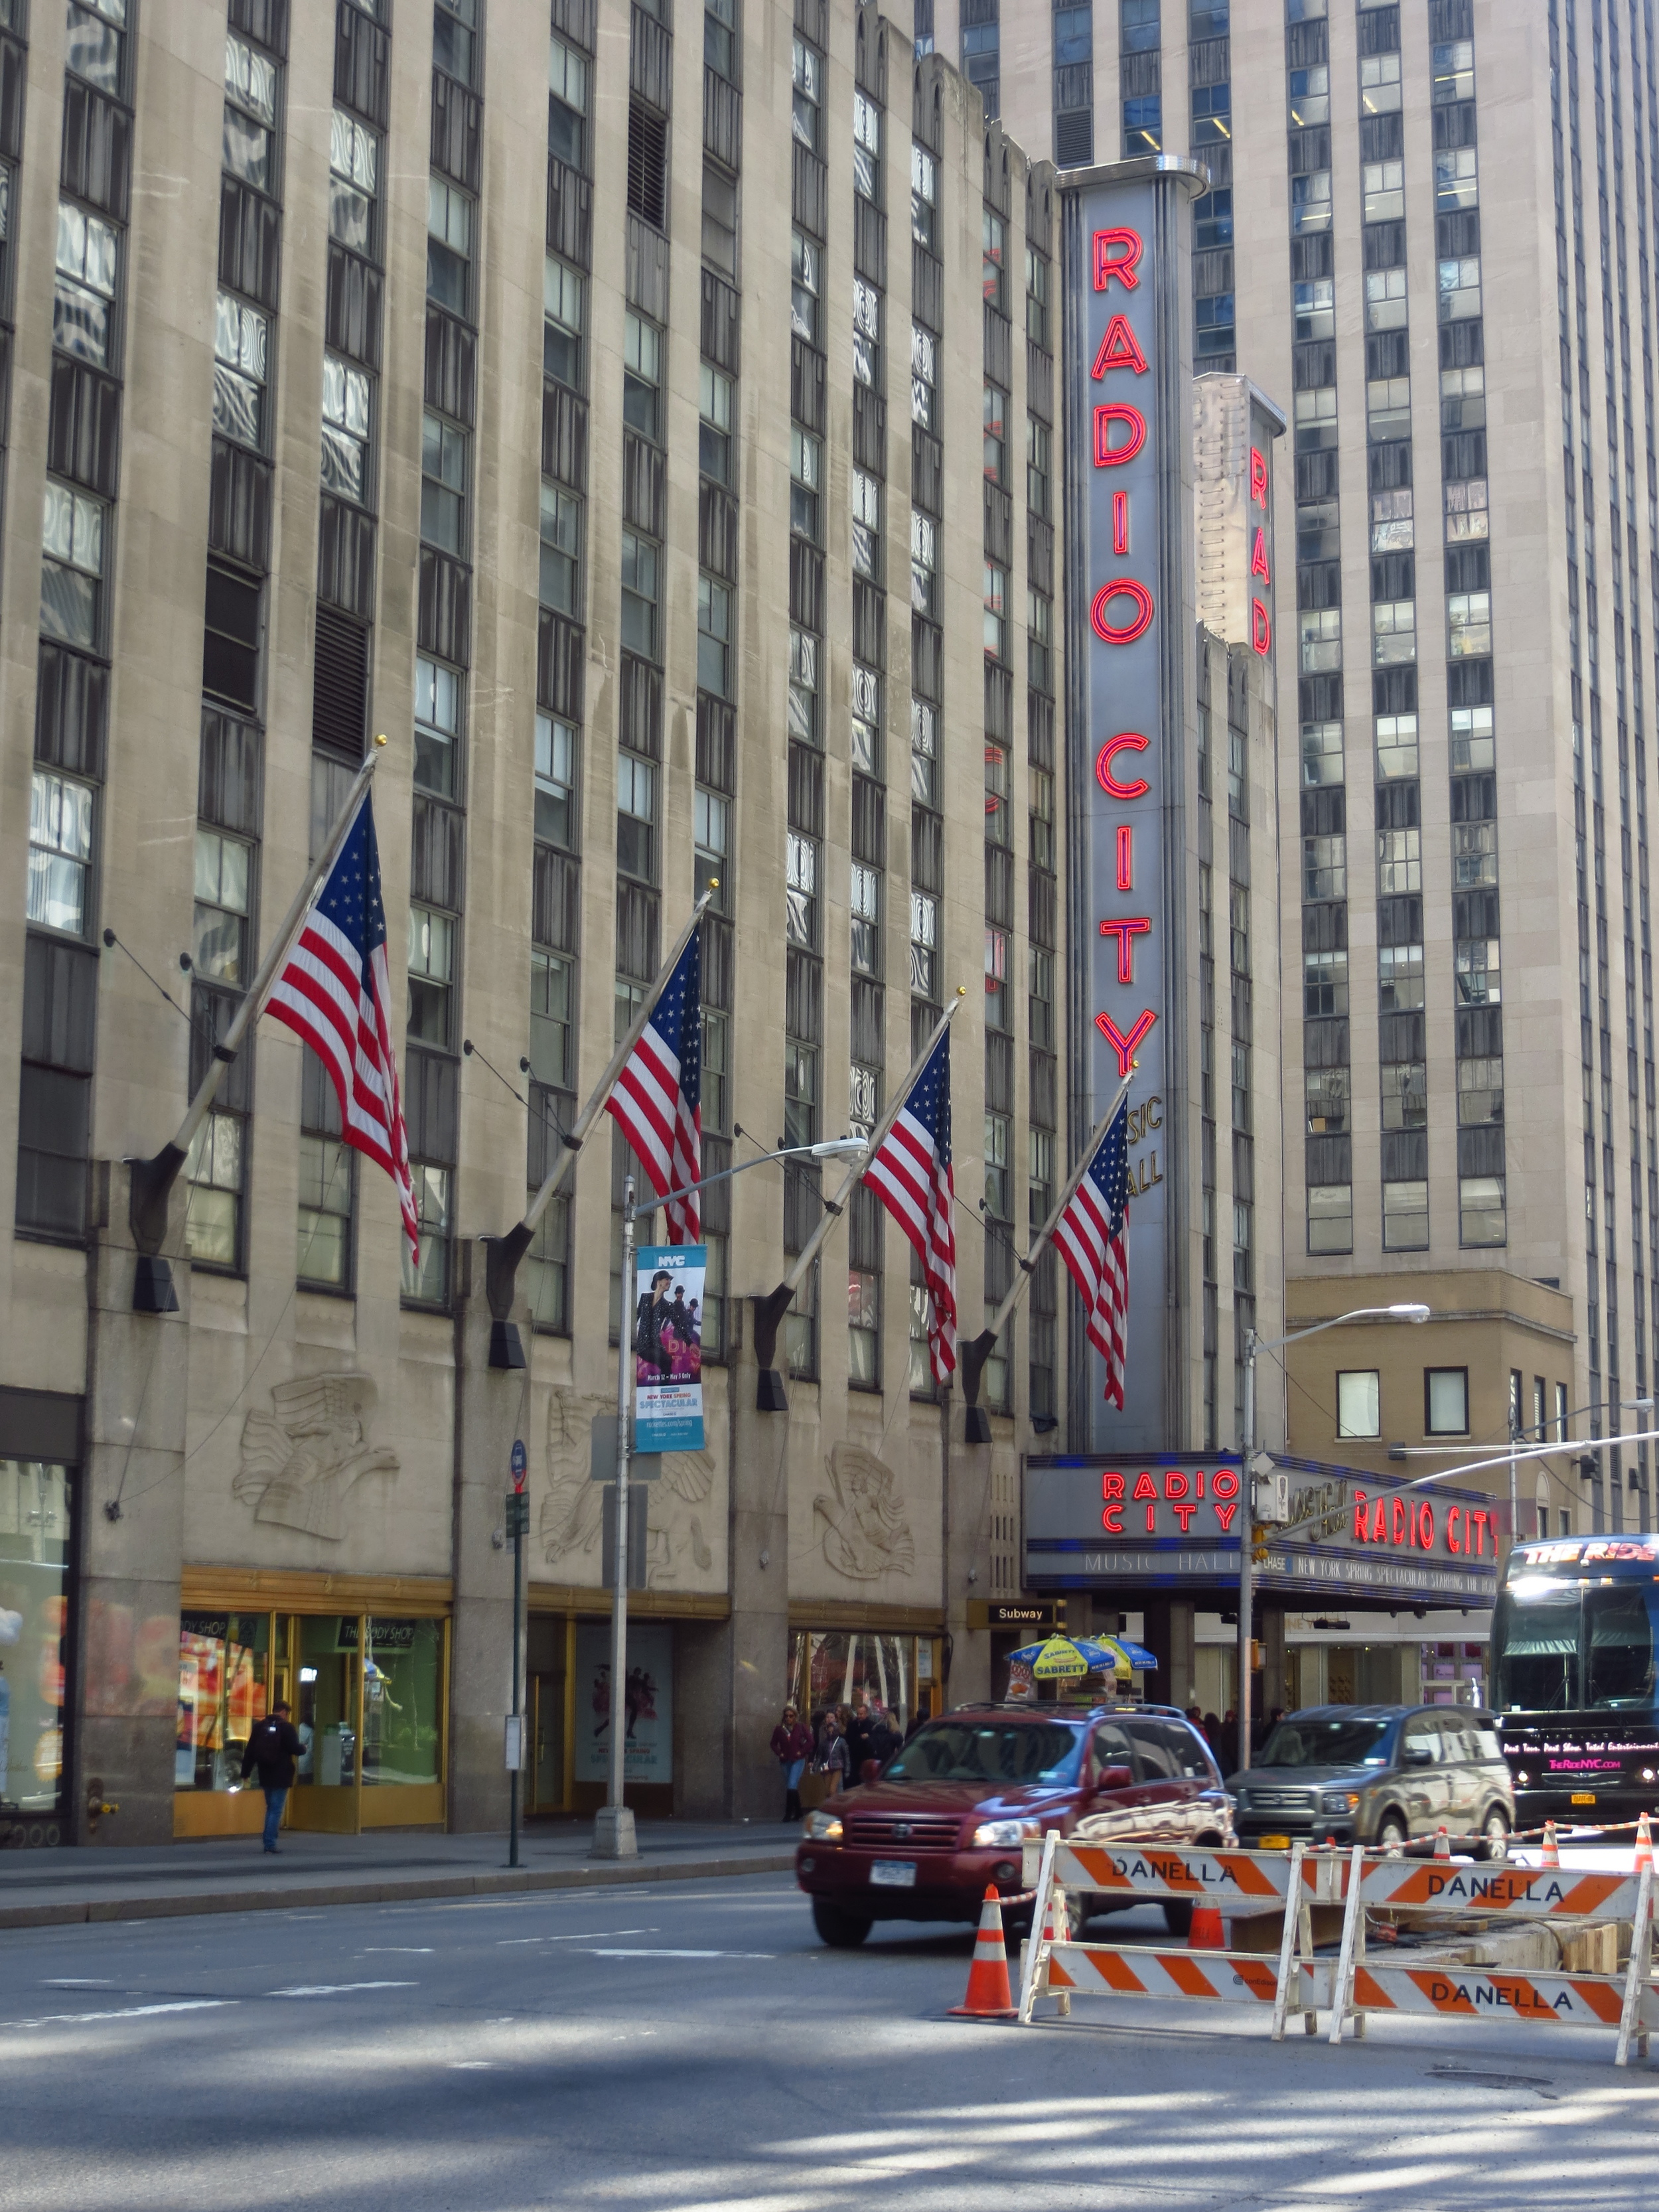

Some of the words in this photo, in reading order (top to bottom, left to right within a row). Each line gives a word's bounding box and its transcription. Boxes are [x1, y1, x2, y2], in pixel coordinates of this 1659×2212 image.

[1090, 227, 1154, 645] RADIO
[1250, 446, 1271, 656] RAD
[1095, 733, 1158, 1078] CITY
[1128, 1096, 1162, 1145] SIC
[1128, 1150, 1163, 1197] ALL
[658, 1254, 685, 1267] NYC
[640, 1398, 698, 1409] SPECTACULAR
[1102, 1469, 1240, 1500] RADIO
[1102, 1503, 1238, 1533] CITY
[1354, 1489, 1434, 1550] RADIO
[1084, 1553, 1159, 1572] MUSIC
[1178, 1552, 1241, 1571] HALL
[1263, 1556, 1286, 1571] CHASE
[1523, 1543, 1583, 1564] THE
[1583, 1542, 1658, 1562] RIDE
[1298, 1557, 1315, 1576] NEW
[1321, 1560, 1340, 1578] YORK
[1346, 1562, 1372, 1581] SPRING
[1376, 1566, 1427, 1587] SPECTACULAR
[1431, 1572, 1463, 1591] STARRING
[1467, 1576, 1478, 1592] THE
[999, 1608, 1043, 1621] Subway
[199, 1621, 226, 1635] SHOP
[390, 1627, 414, 1640] SHOP
[1037, 1664, 1086, 1674] SABRETT
[1585, 1741, 1605, 1751] Total
[1112, 1858, 1238, 1883] DANELLA
[1428, 1874, 1565, 1903] DANELLA
[1431, 1982, 1573, 2010] DANELLA
